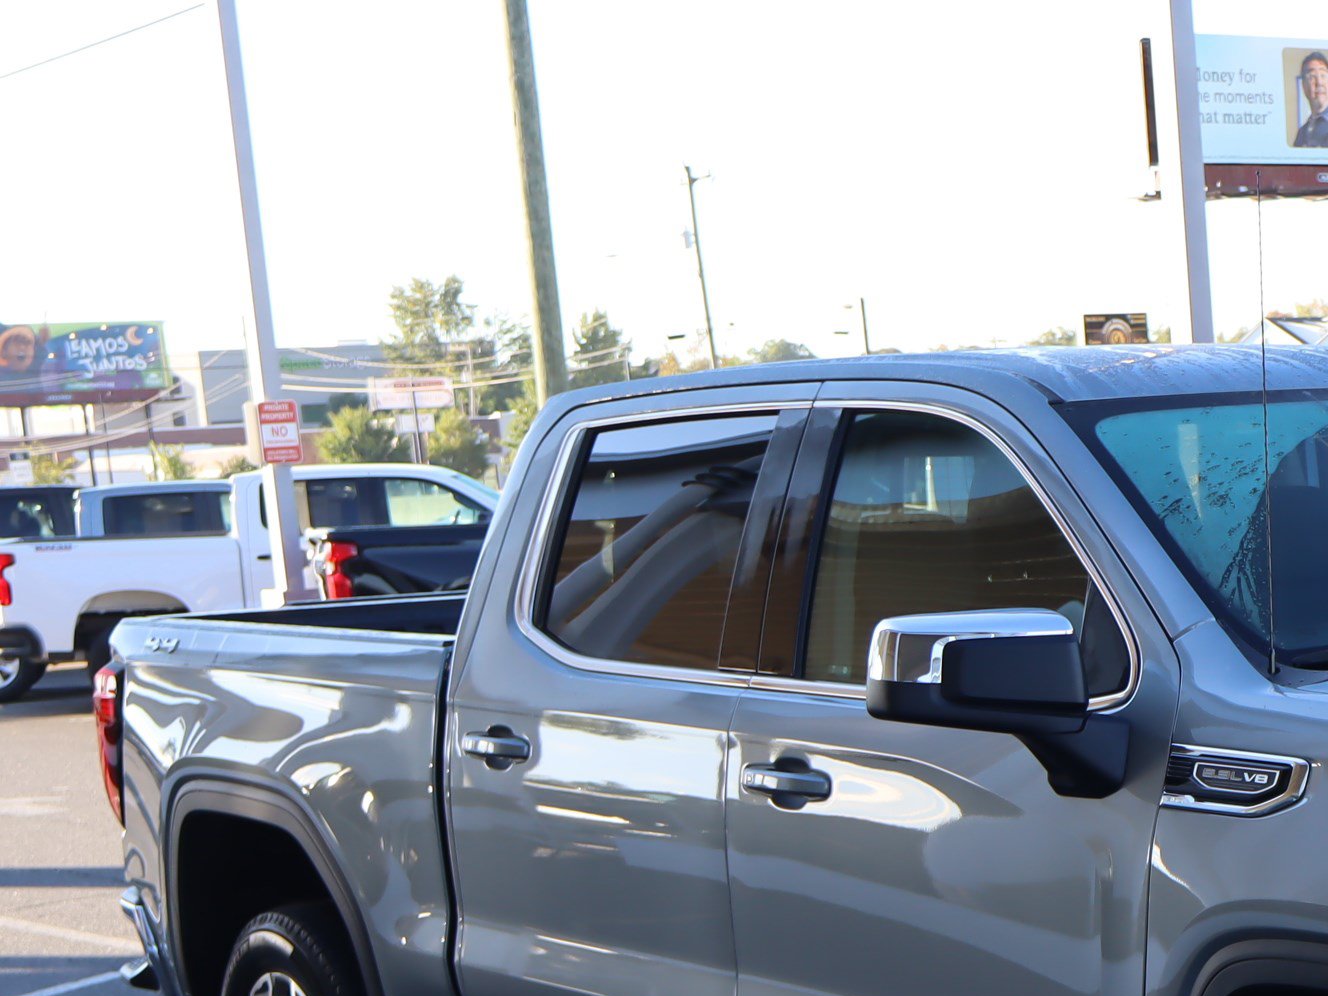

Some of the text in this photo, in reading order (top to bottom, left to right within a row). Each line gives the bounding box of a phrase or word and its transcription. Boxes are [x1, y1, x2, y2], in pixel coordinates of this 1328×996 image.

[1239, 68, 1257, 83] for
[1214, 91, 1274, 105] moments
[65, 336, 128, 360] LEAMOS
[78, 353, 147, 378] JUNTOS
[261, 411, 294, 420] PROPERTY
[271, 426, 288, 438] NO
[1243, 772, 1269, 784] V8
